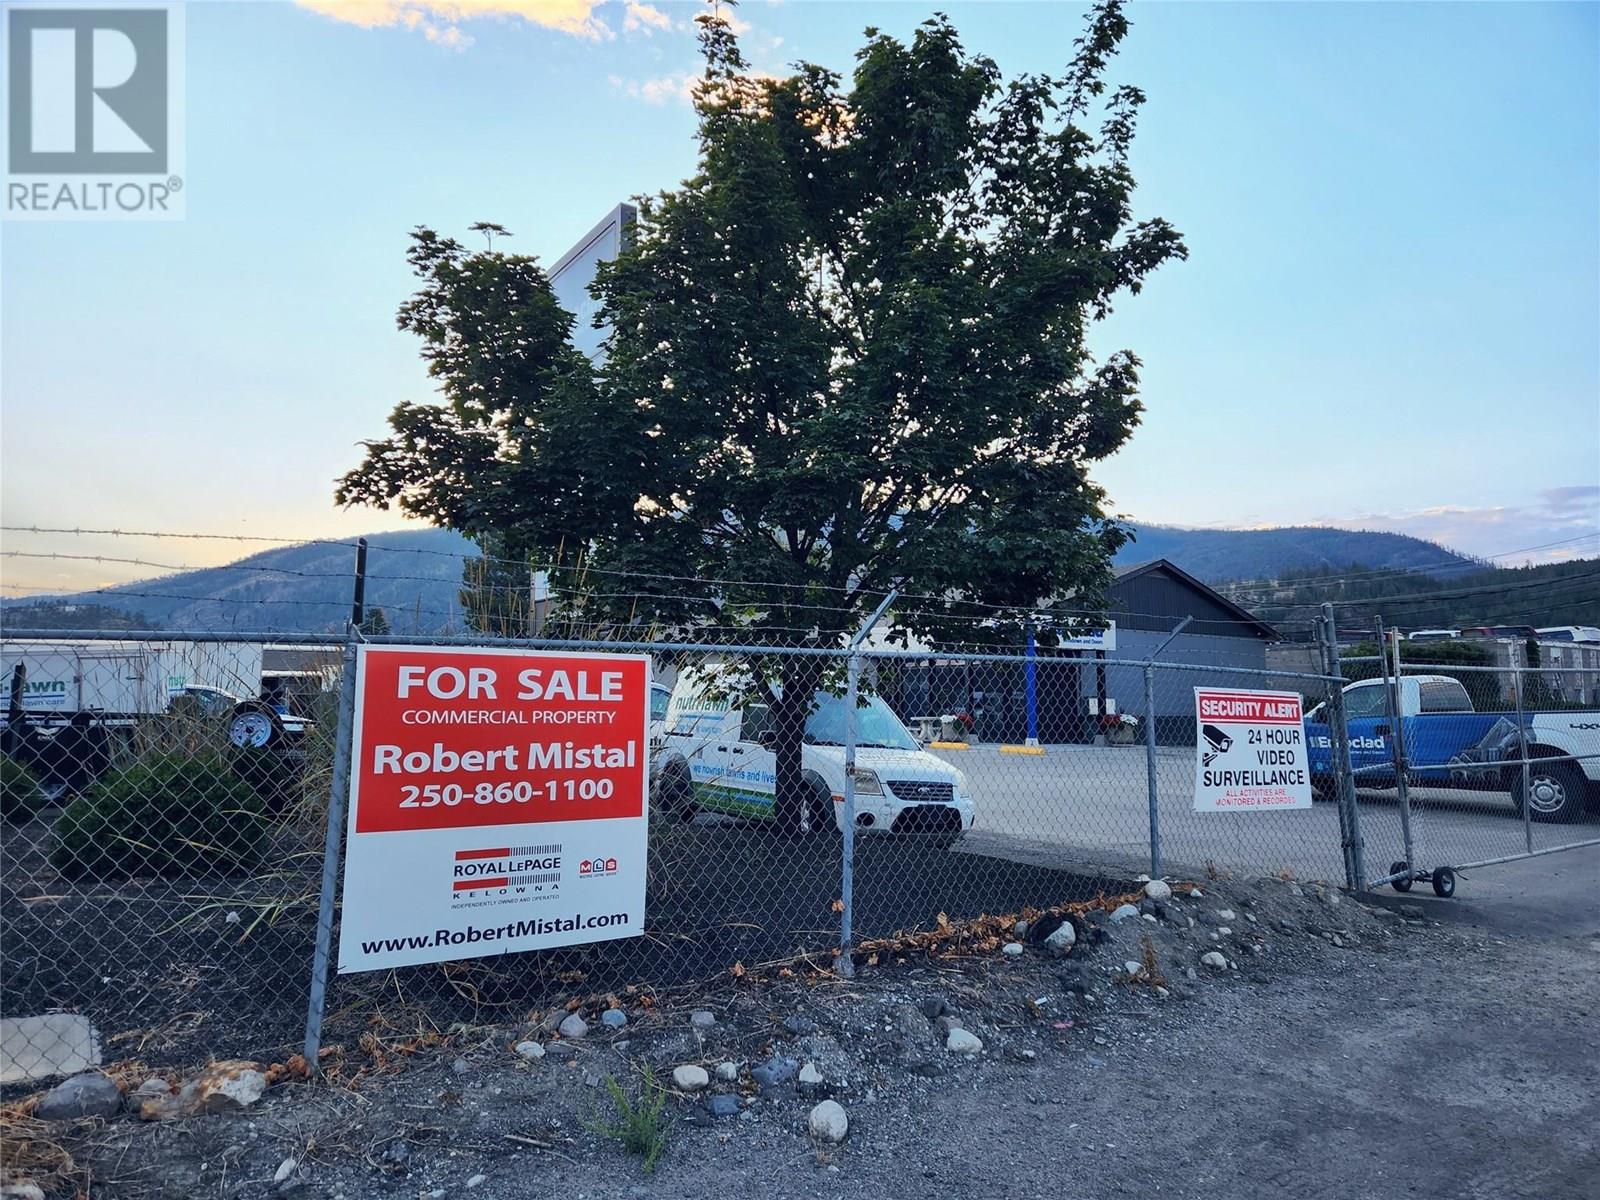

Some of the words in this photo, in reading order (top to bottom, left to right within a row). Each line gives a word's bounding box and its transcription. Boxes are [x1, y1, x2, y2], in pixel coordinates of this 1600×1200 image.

[397, 665, 498, 700] FOR
[517, 668, 624, 702] SALE
[402, 710, 529, 725] COMMERCIAL
[532, 711, 617, 725] PROPERTY
[1201, 699, 1261, 717] SECURITY
[1264, 702, 1299, 719] ALERT
[1248, 729, 1262, 745] 24
[1265, 729, 1301, 745] HOUR
[373, 742, 519, 775] Robert
[527, 739, 636, 770] Mistal
[1257, 749, 1295, 766] VIDEO
[747, 770, 760, 781] and
[1203, 769, 1305, 787] SURVEILLANCE
[399, 777, 614, 809] 250-860-1100
[1226, 789, 1237, 798] ALL
[453, 861, 507, 877] ROYAL
[452, 883, 560, 900] KELOWNA
[450, 901, 497, 910] INDEPENDENTLY
[498, 898, 519, 906] OWNED
[531, 894, 560, 902] OPERATED
[361, 912, 629, 955] www.RobertMistal.com
